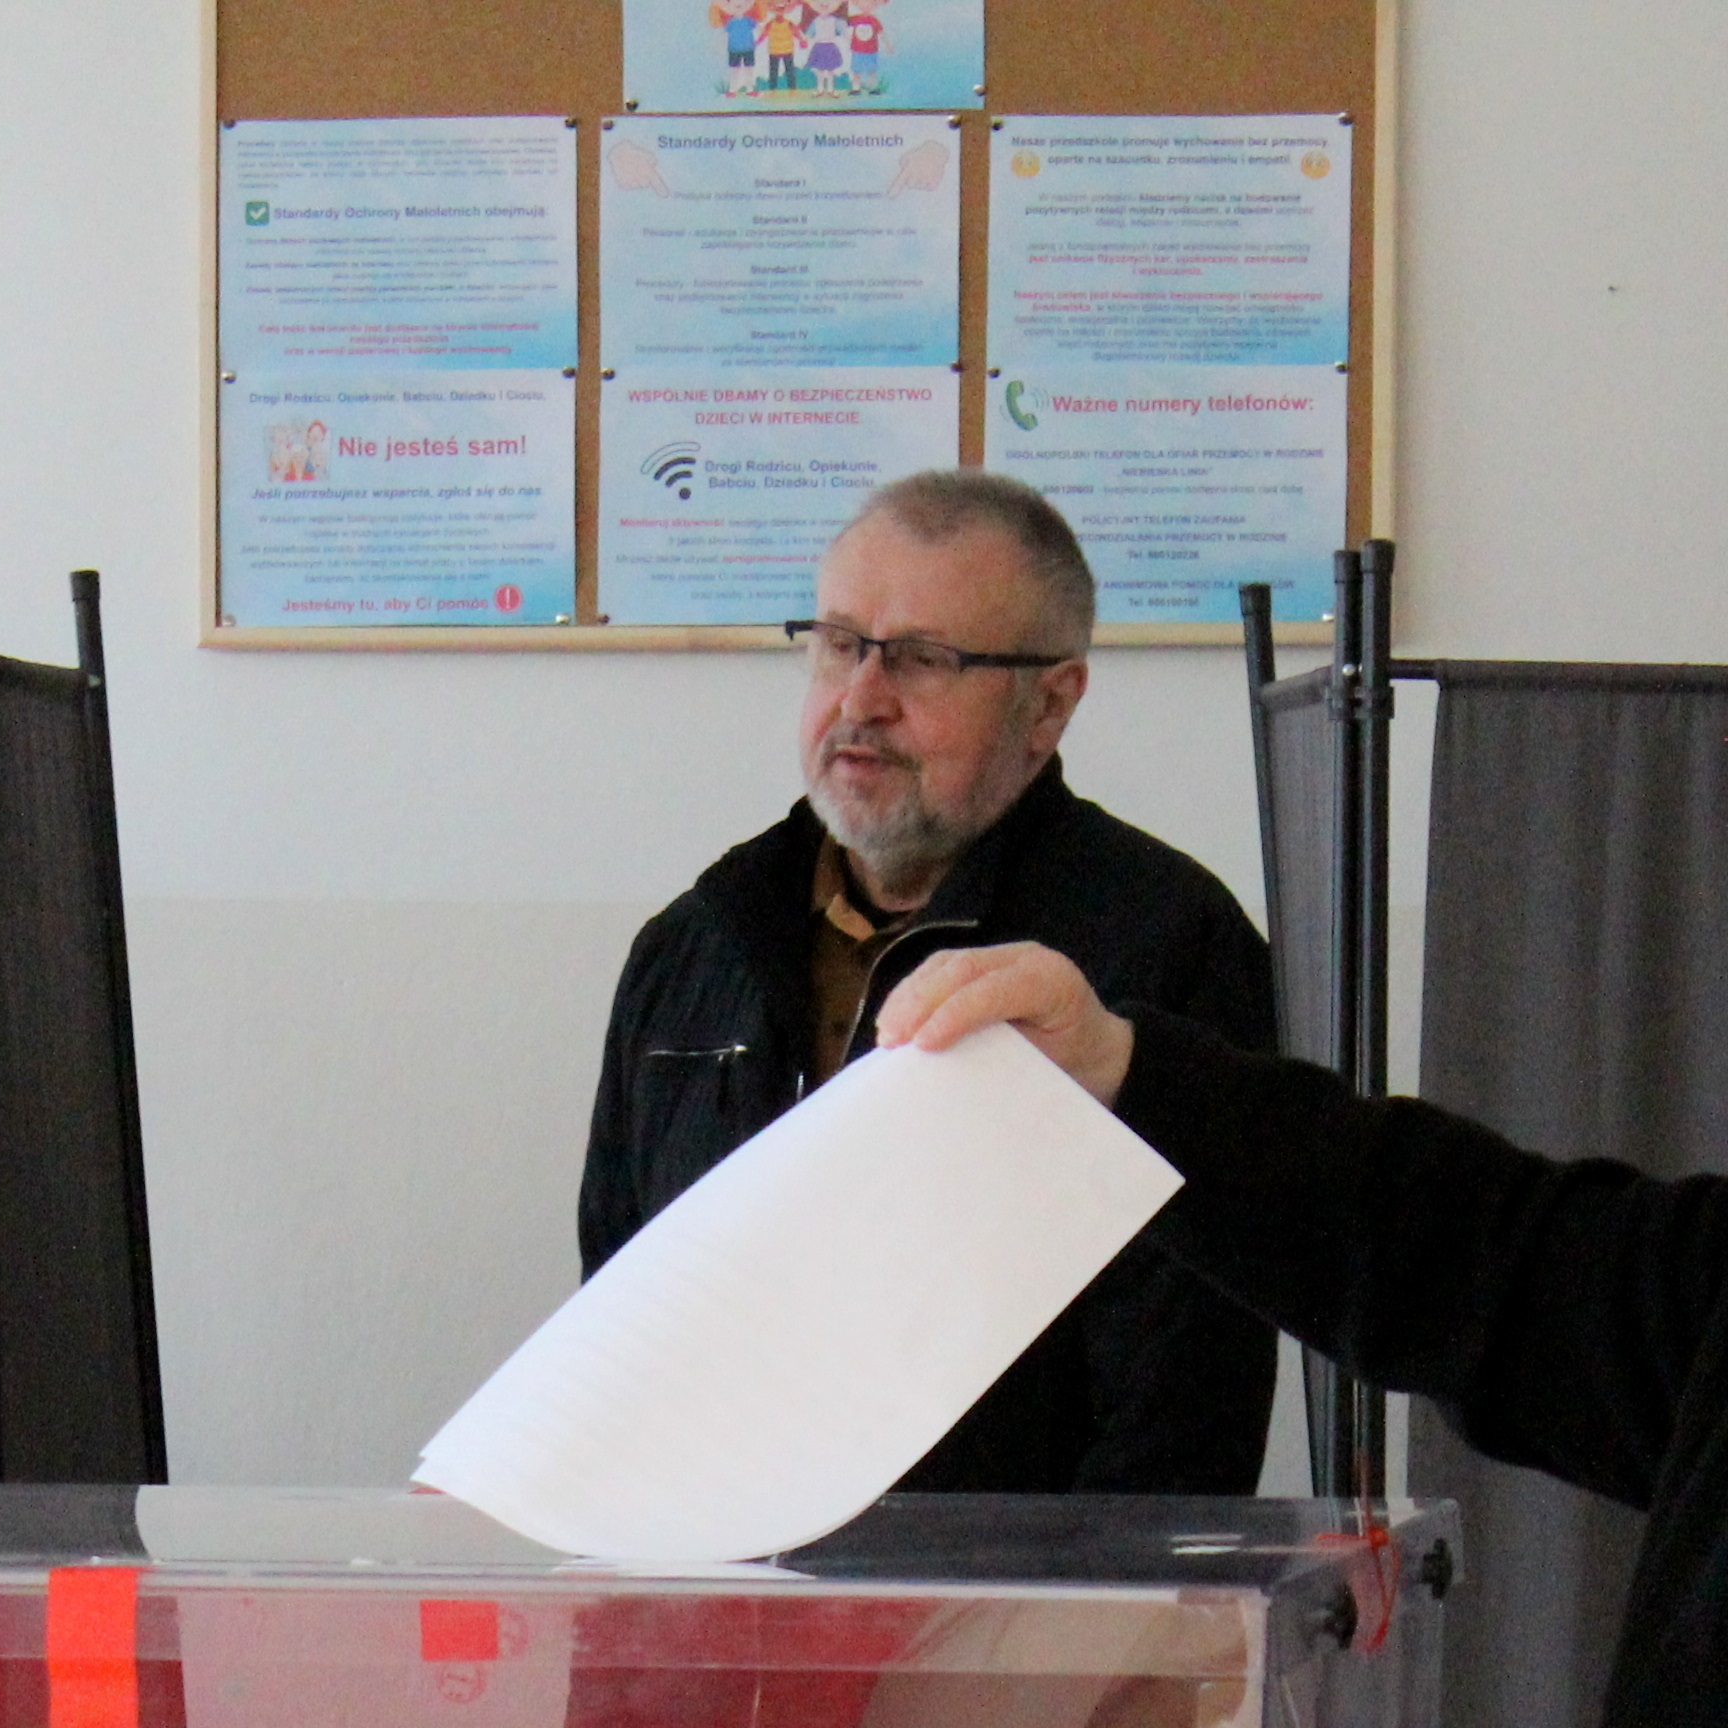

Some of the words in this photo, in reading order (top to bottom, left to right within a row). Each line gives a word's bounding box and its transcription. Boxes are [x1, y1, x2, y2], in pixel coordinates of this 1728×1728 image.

[657, 135, 736, 151] Standardy
[742, 135, 808, 150] Ochrony
[814, 134, 904, 148] Małoletnich
[274, 207, 340, 221] Standardy
[345, 206, 401, 220] Ochrony
[628, 388, 708, 402] WSPÓLNIE
[713, 388, 768, 401] DBAMY
[773, 389, 785, 401] O
[790, 386, 933, 401] BEZPIECZEŃSTWO
[1052, 395, 1118, 413] Ważne
[1126, 396, 1201, 416] numery
[1208, 394, 1314, 411] telefonów:
[695, 412, 745, 425] DZIECI
[748, 412, 766, 425] W
[338, 437, 378, 457] Nie
[385, 436, 459, 462] jesteś
[467, 435, 527, 456] sam!
[705, 460, 742, 473] Drogi
[499, 486, 514, 496] do
[282, 598, 355, 614] Jesteśmy
[383, 596, 411, 612] aby
